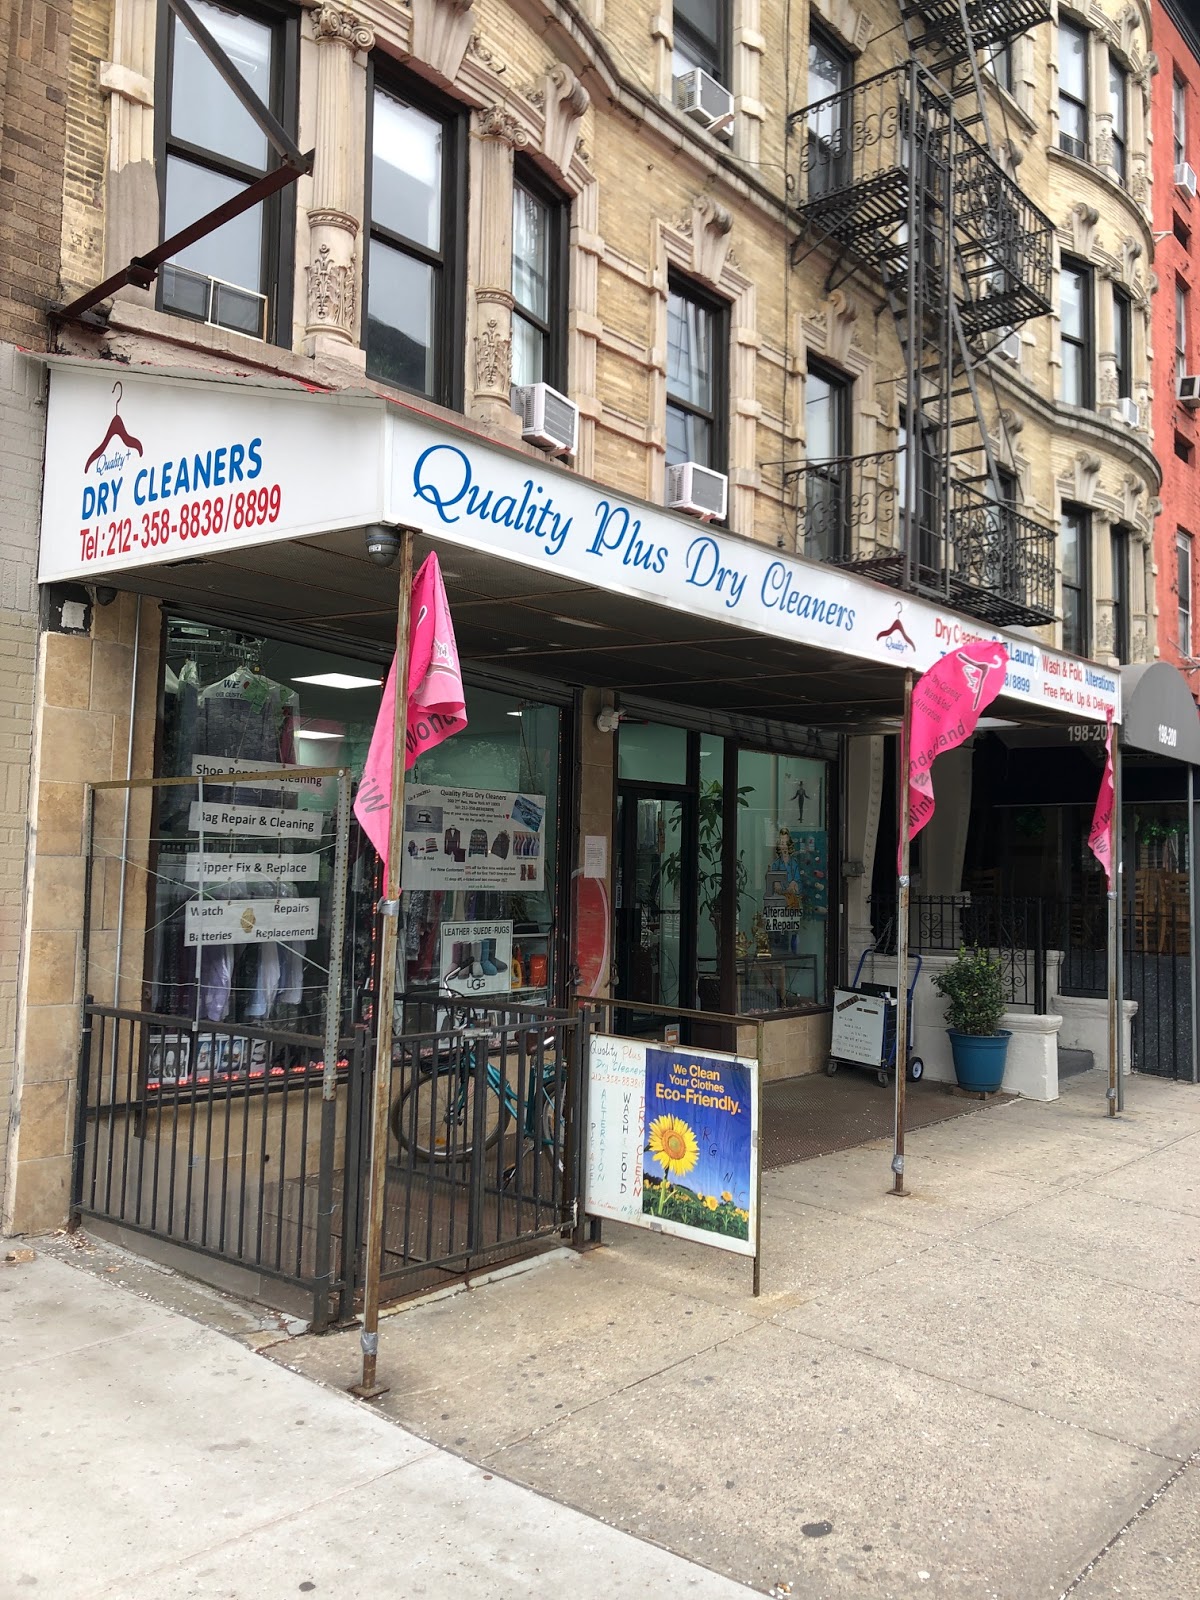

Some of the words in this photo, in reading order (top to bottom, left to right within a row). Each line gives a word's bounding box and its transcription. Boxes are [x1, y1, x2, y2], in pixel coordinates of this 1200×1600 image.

[81, 476, 124, 520] DRY
[133, 437, 263, 506] CLEANERS
[412, 443, 574, 556] Quality
[585, 500, 669, 575] Plus
[685, 536, 748, 609] Dry
[760, 560, 856, 632] Cleaners
[934, 617, 952, 646] Dry
[953, 623, 988, 645] Cleani
[1041, 654, 1061, 676] Wash
[1062, 661, 1068, 677] &
[1069, 662, 1083, 682] Fold
[1084, 668, 1116, 693] Alterations
[223, 679, 241, 689] WE
[1043, 681, 1058, 699] Free
[1060, 686, 1074, 702] Pick
[1077, 691, 1085, 708] Up
[1086, 694, 1091, 707] &
[1067, 725, 1108, 742] 198-20
[1158, 723, 1177, 747] 198-200
[196, 764, 224, 776] Shoe
[440, 789, 461, 799] Quality
[474, 792, 484, 800] Dry
[485, 792, 507, 801] Cleaners
[221, 813, 255, 826] Repair
[259, 815, 267, 826] &
[270, 817, 315, 832] Cleaning
[236, 862, 251, 873] Fix
[254, 863, 262, 872] &
[266, 863, 307, 875] Replace
[191, 907, 224, 917] Watch
[274, 904, 310, 914] Repairs
[763, 906, 803, 918] Alterations
[256, 928, 315, 940] Replacement
[766, 919, 771, 930] &
[772, 919, 800, 934] Repairs
[466, 979, 486, 990] UGG
[673, 1063, 687, 1076] We
[689, 1064, 720, 1081] Clean
[669, 1074, 689, 1088] Your
[690, 1079, 725, 1094] Clothes
[655, 1083, 742, 1116] Eco-Friendly.
[622, 1091, 632, 1135] WASH
[619, 1152, 628, 1194] FOLD
[633, 1145, 644, 1198] CLEAN
